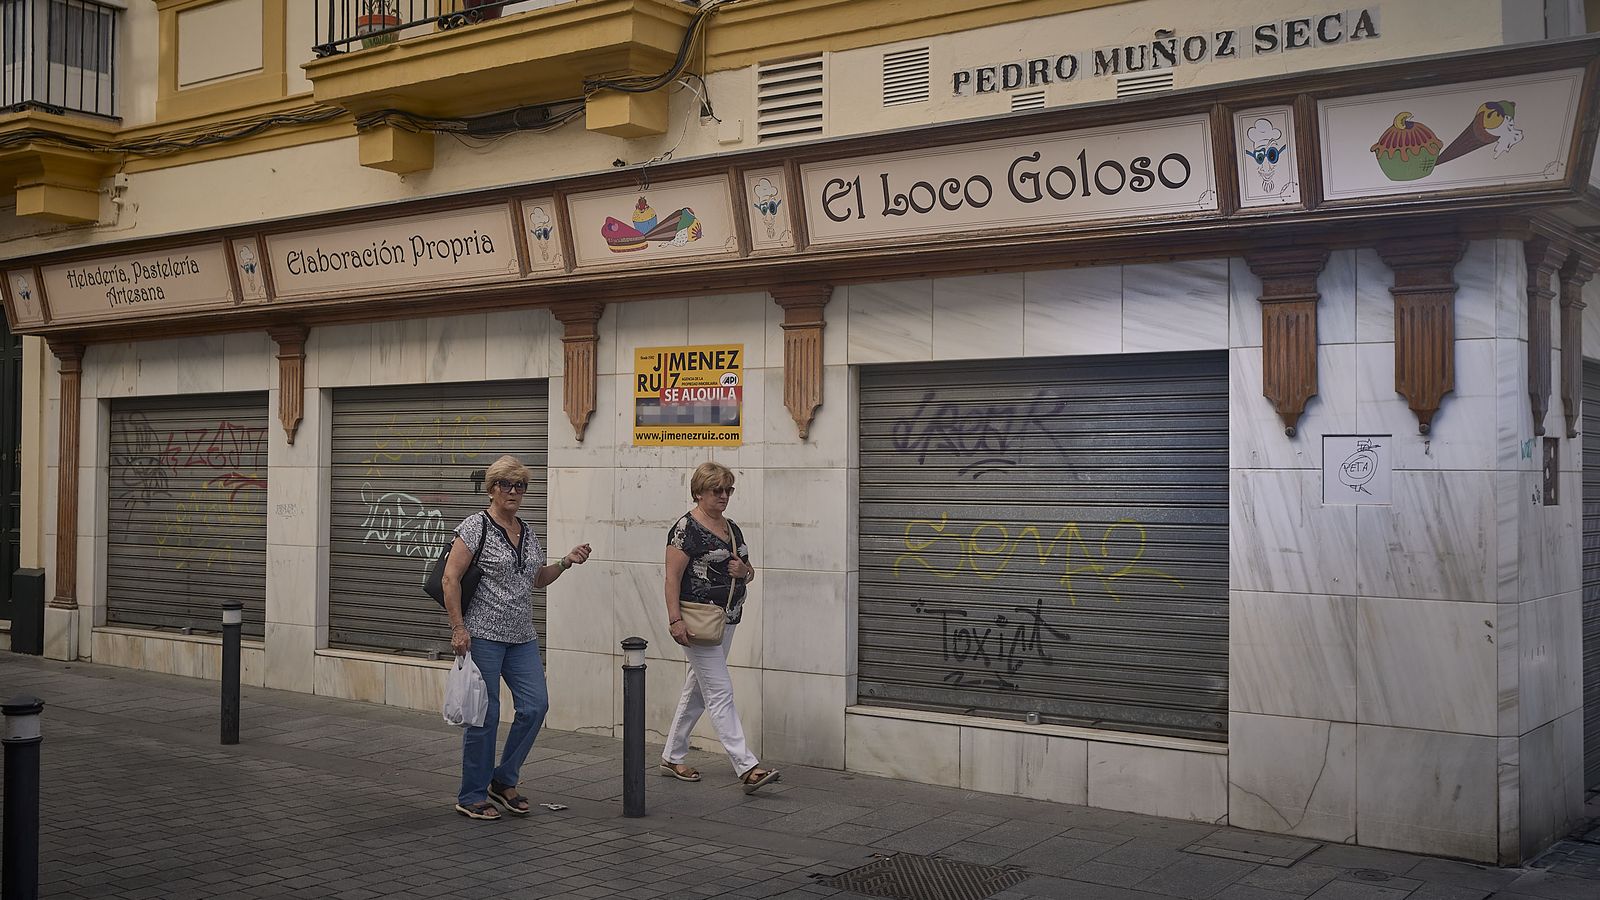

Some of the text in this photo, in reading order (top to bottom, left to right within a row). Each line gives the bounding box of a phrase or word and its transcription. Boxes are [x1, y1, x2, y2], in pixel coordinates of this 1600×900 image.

[952, 9, 1379, 95] PEDRO MUÑOZ SECA
[822, 149, 1191, 222] El Loco Goloso
[286, 229, 495, 276] Elaboración Propria
[67, 255, 200, 289] Heladería, Pastelería
[106, 286, 165, 308] Artesana
[653, 351, 739, 371] JIMENEZ
[721, 376, 737, 385] API
[664, 386, 737, 402] SE ALQUILA
[635, 430, 740, 442] www.jimenezruiz.com
